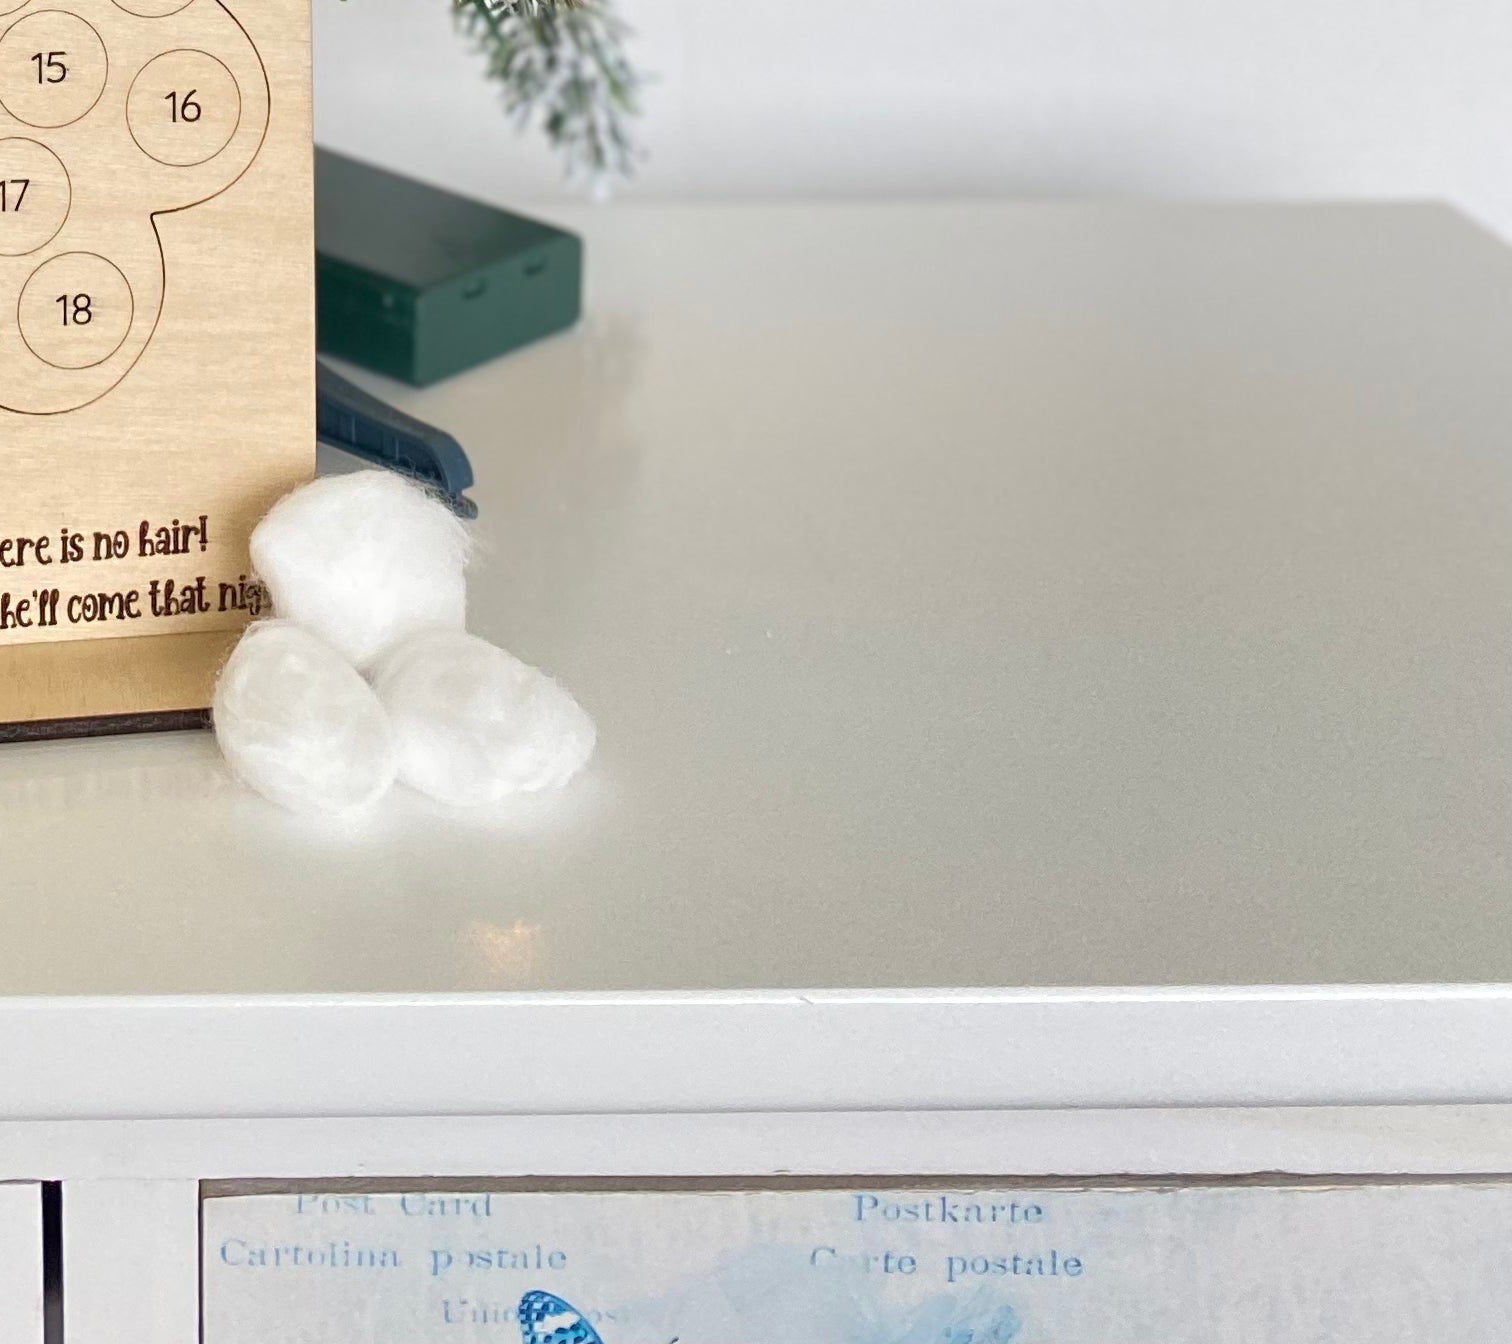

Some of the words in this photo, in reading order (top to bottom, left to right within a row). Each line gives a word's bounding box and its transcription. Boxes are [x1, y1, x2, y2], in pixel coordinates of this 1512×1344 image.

[29, 50, 68, 86] 15
[163, 87, 203, 124] 16
[54, 292, 94, 328] 18
[59, 526, 84, 564] is
[92, 528, 130, 561] no
[137, 514, 209, 557] hair!
[66, 588, 142, 624] come
[148, 575, 211, 617] that
[851, 1193, 1045, 1224] Postkarte
[219, 1238, 400, 1269] Cartolina
[946, 1249, 1084, 1283] postale
